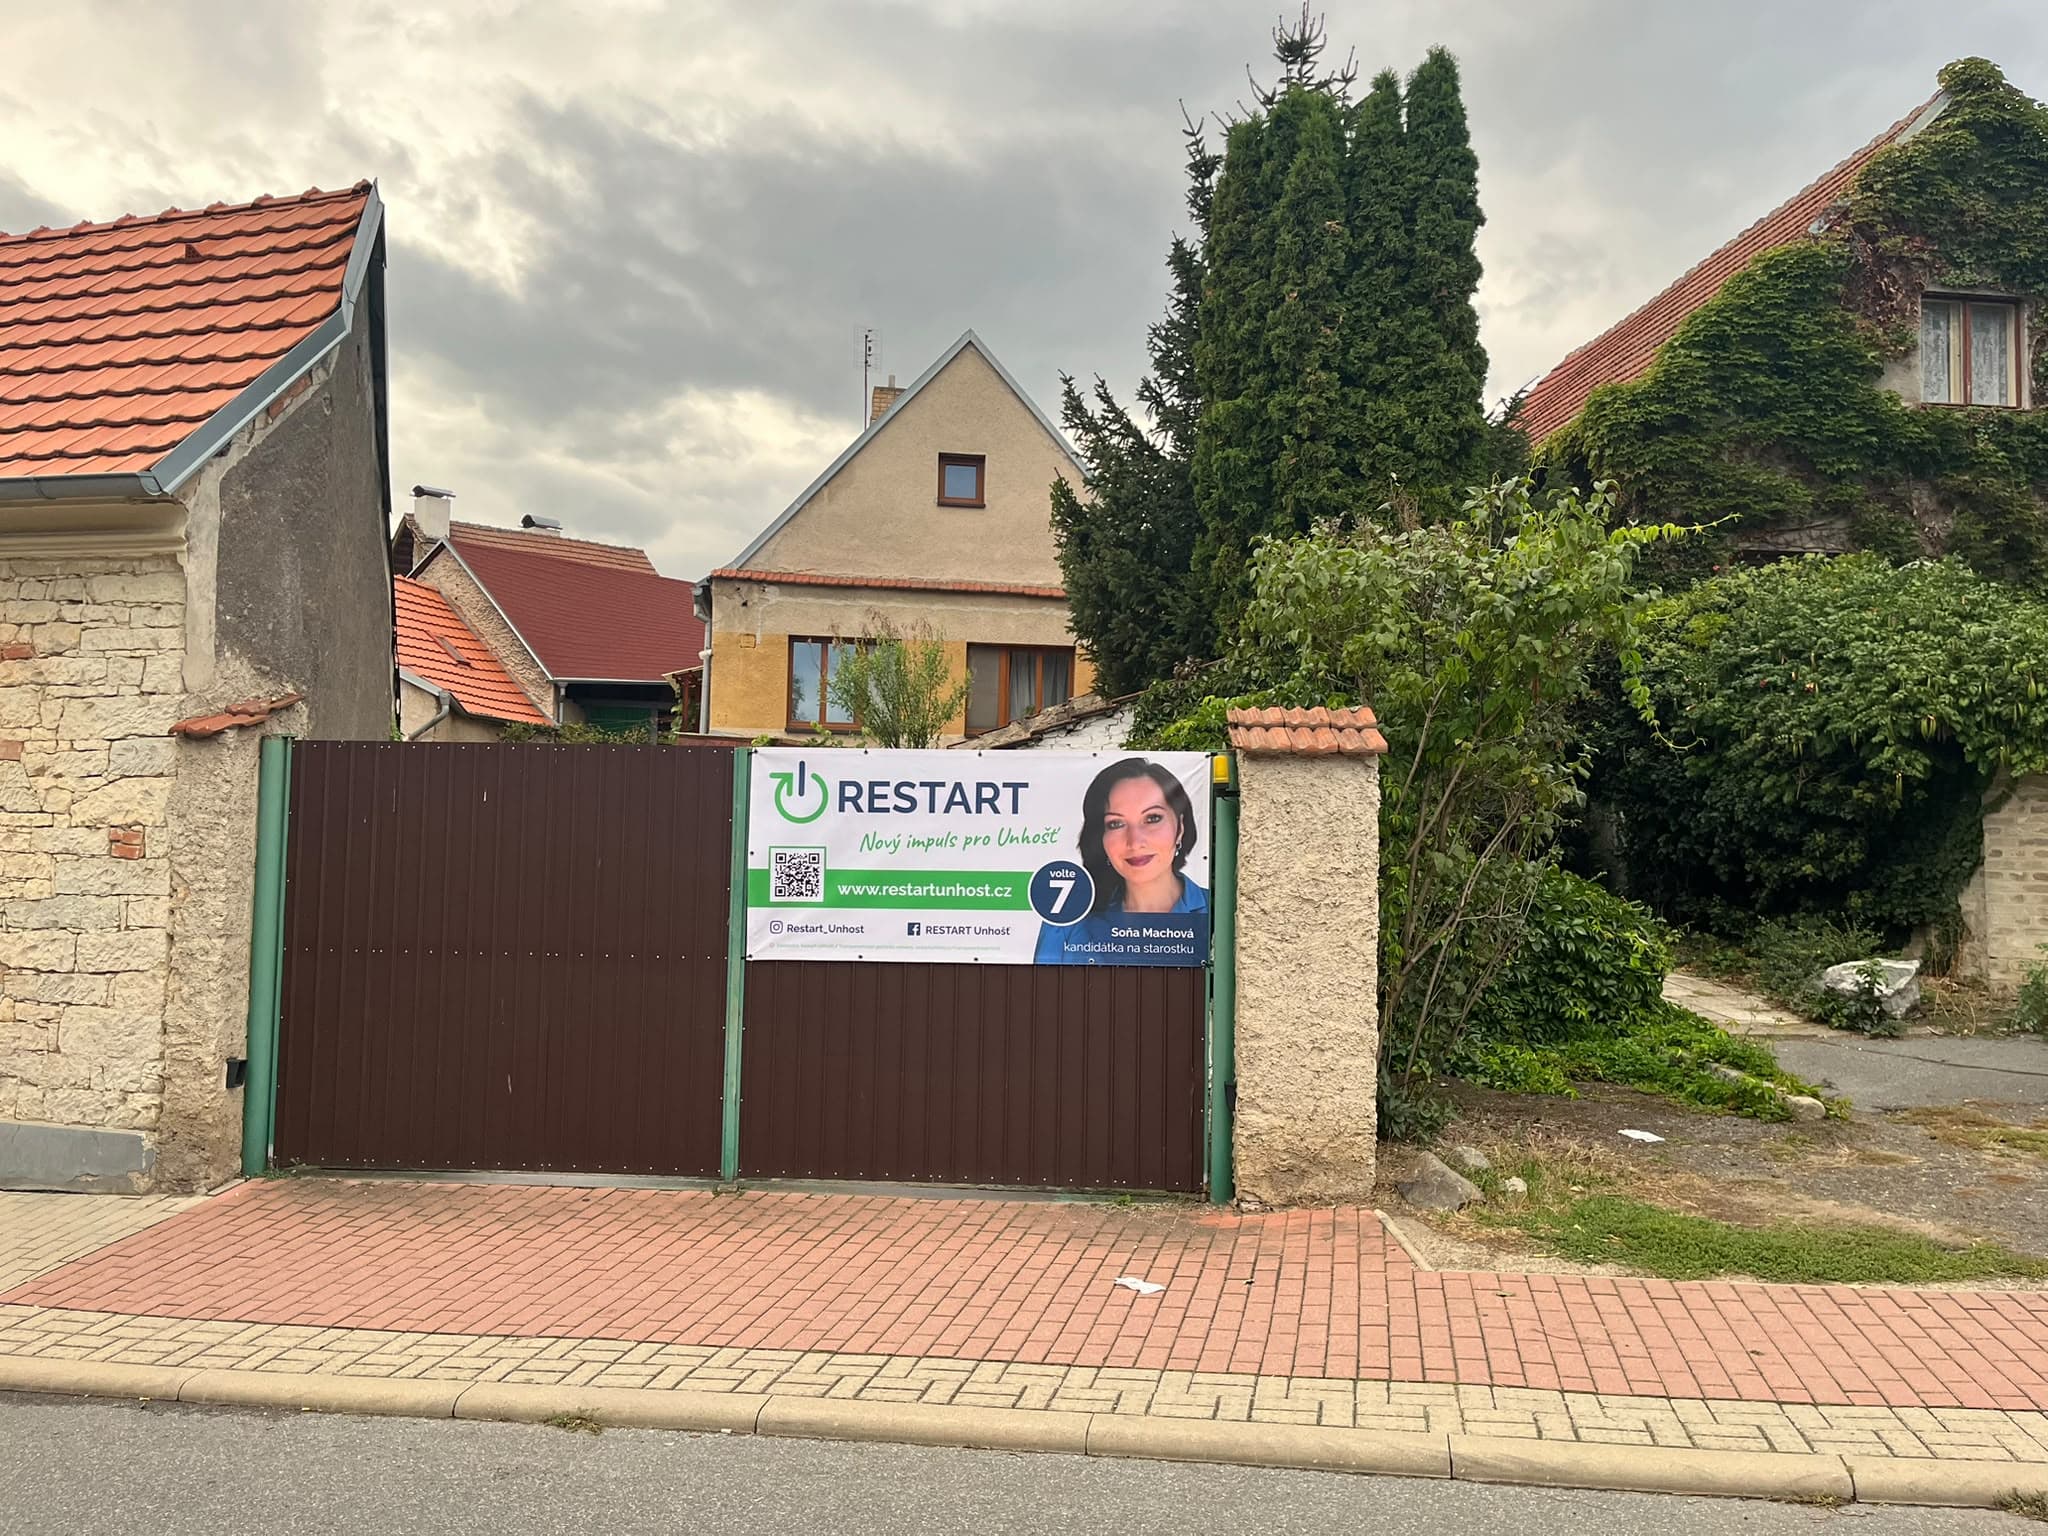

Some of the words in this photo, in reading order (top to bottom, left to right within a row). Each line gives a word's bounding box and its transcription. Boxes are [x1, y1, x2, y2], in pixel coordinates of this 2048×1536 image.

[838, 780, 1029, 814] RESTART
[859, 831, 902, 854] Nový
[906, 831, 958, 853] impuls
[962, 836, 991, 852] pro
[997, 826, 1061, 847] Unhošť
[1050, 869, 1077, 878] volte
[837, 882, 1013, 898] www.restartunhost.cz
[1049, 879, 1076, 914] 7
[786, 923, 865, 935] Restart_Unhost
[925, 925, 971, 936] RESTART
[973, 925, 1011, 937] Unhošť
[1111, 927, 1140, 938] Soňa
[1142, 927, 1194, 939] Machová
[1064, 943, 1124, 953] kandidátka
[1126, 945, 1141, 953] na
[1143, 943, 1194, 955] starostku
